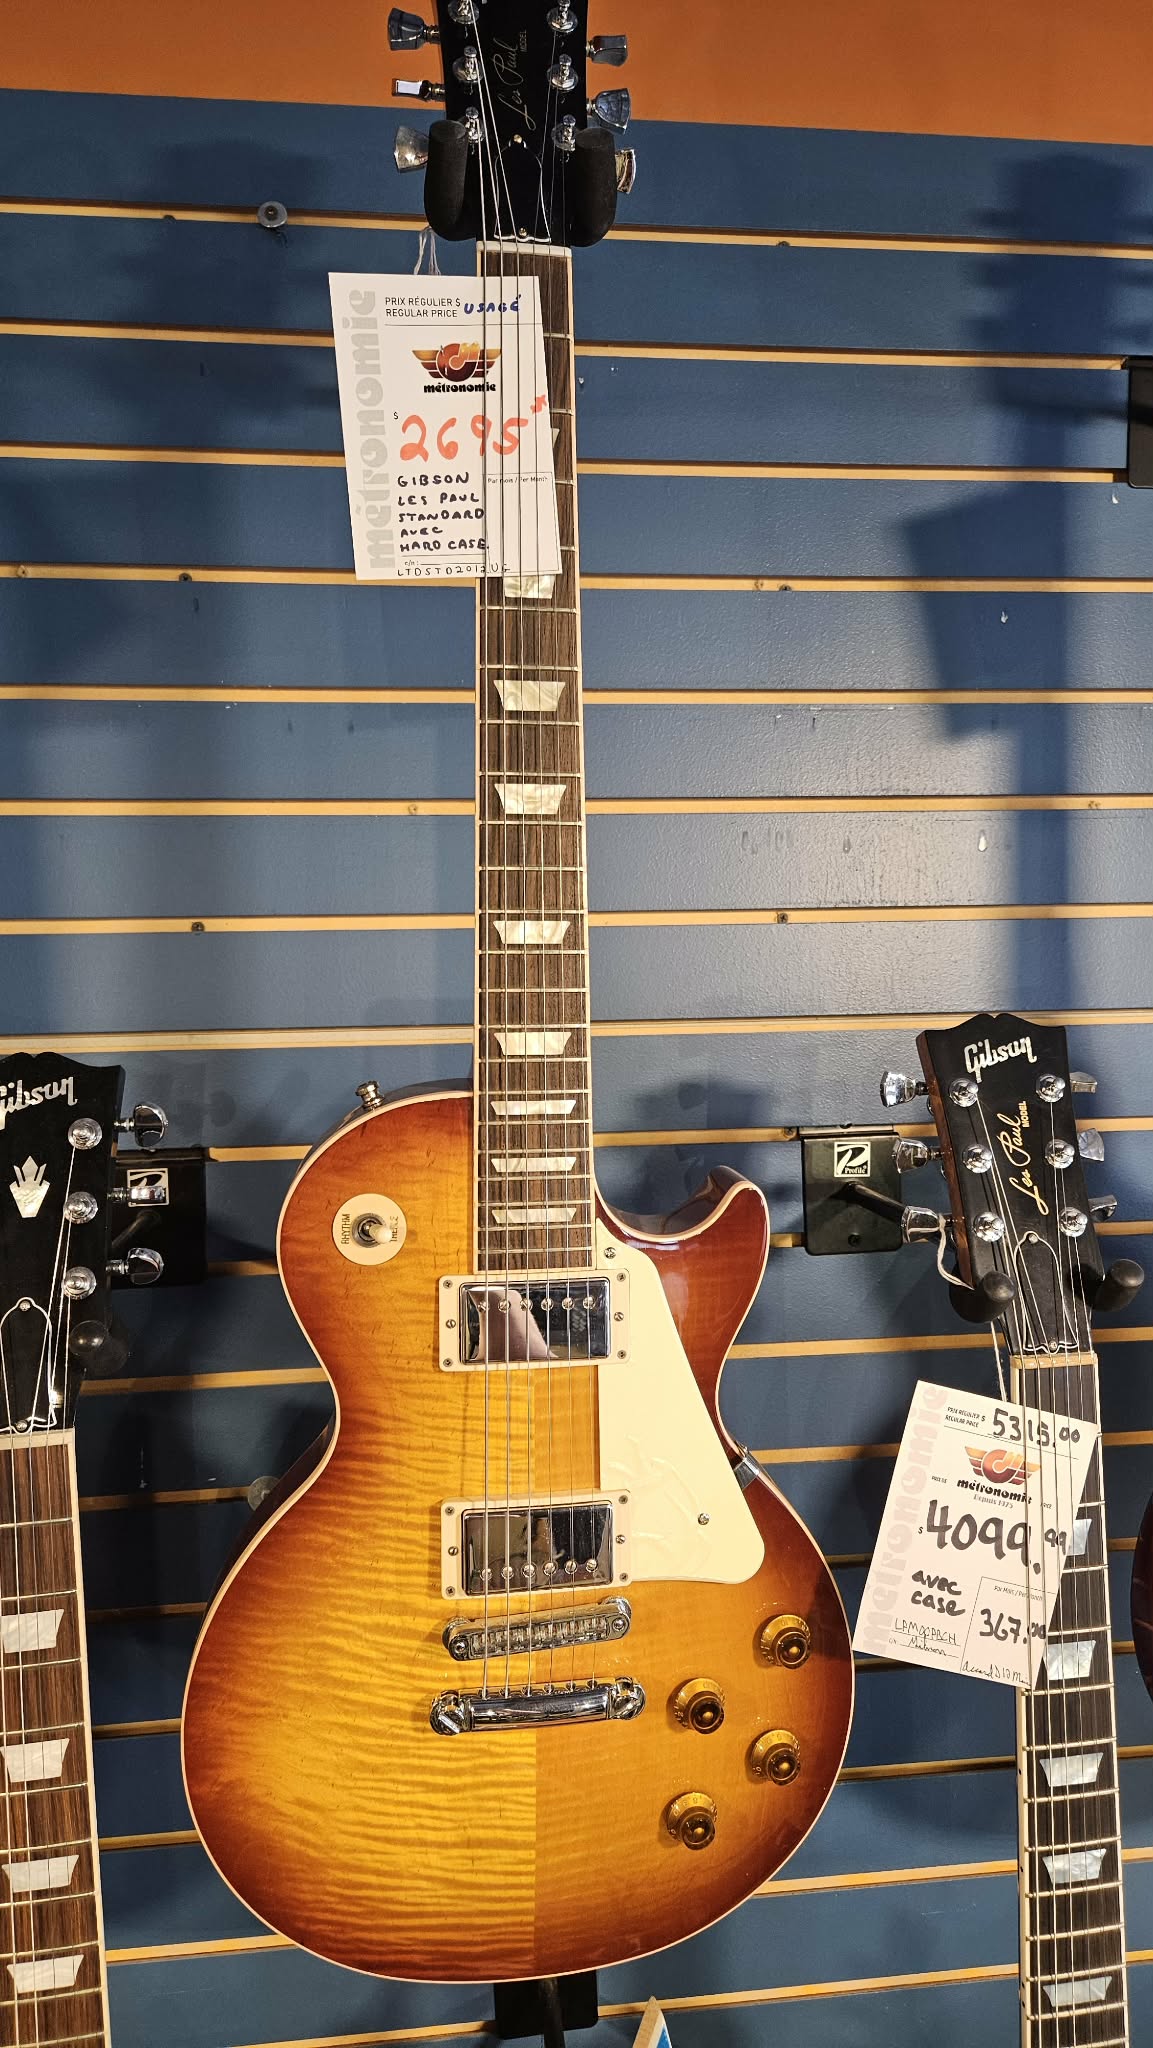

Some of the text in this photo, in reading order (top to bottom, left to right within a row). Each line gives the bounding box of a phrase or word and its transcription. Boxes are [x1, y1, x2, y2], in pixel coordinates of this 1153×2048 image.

[493, 37, 523, 85] Paul
[385, 297, 405, 306] PRIX
[408, 295, 452, 307] RÉGULIER
[455, 297, 461, 307] $
[386, 308, 458, 318] REGULAR PRICE
[424, 382, 496, 393] métronomie
[398, 471, 469, 487] GIBSON
[398, 492, 480, 506] LES PAUL
[398, 509, 485, 522] STANDARD
[400, 527, 443, 538] AVEC
[399, 540, 441, 552] HARD
[964, 1036, 1038, 1083] Gibson
[1018, 1100, 1030, 1128] MODEL
[996, 1112, 1049, 1216] Les Paul
[341, 1213, 351, 1245] RHYTHM
[911, 1570, 962, 1596] avec
[910, 1590, 966, 1617] case
